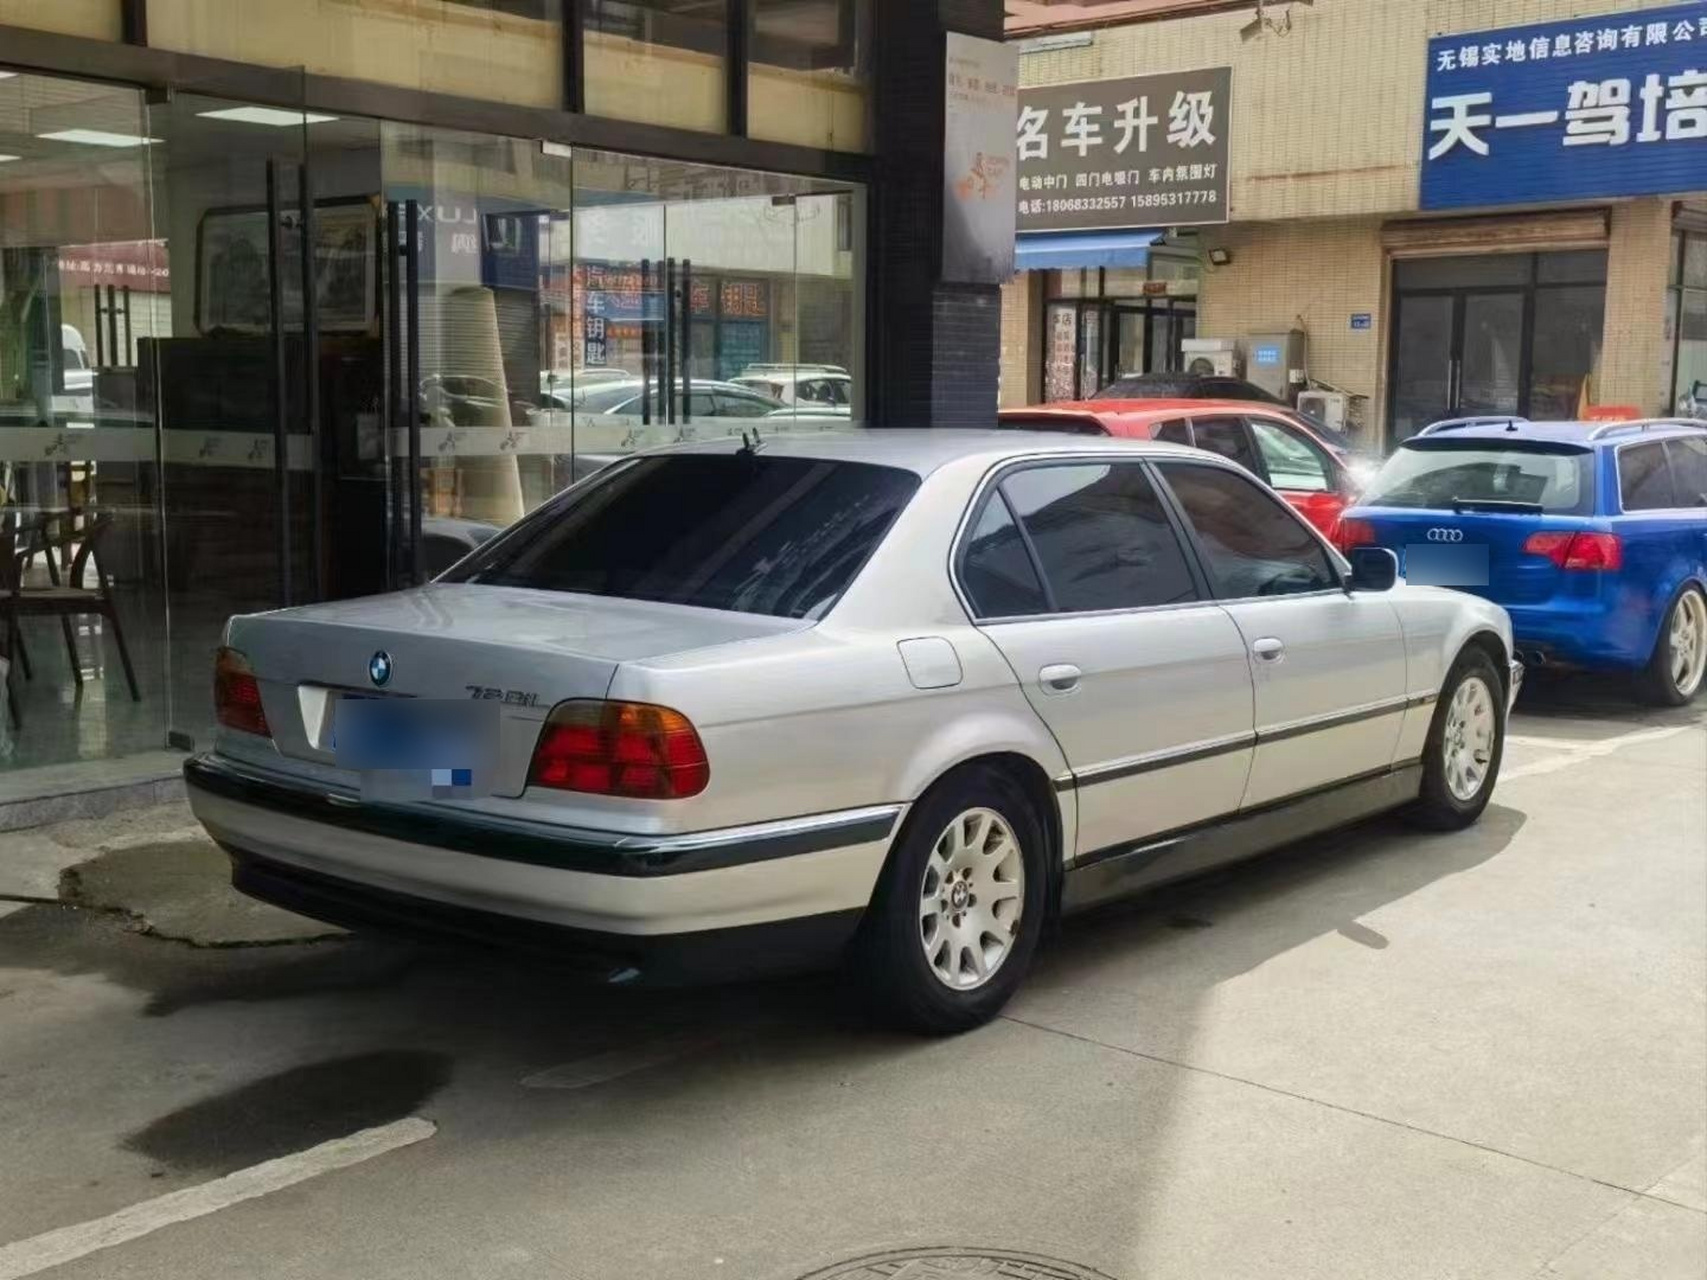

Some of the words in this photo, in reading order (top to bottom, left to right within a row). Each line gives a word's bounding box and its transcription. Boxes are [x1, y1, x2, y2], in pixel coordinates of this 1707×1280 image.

[1016, 90, 1217, 161] 名车升级
[1019, 174, 1068, 191] 电动中门
